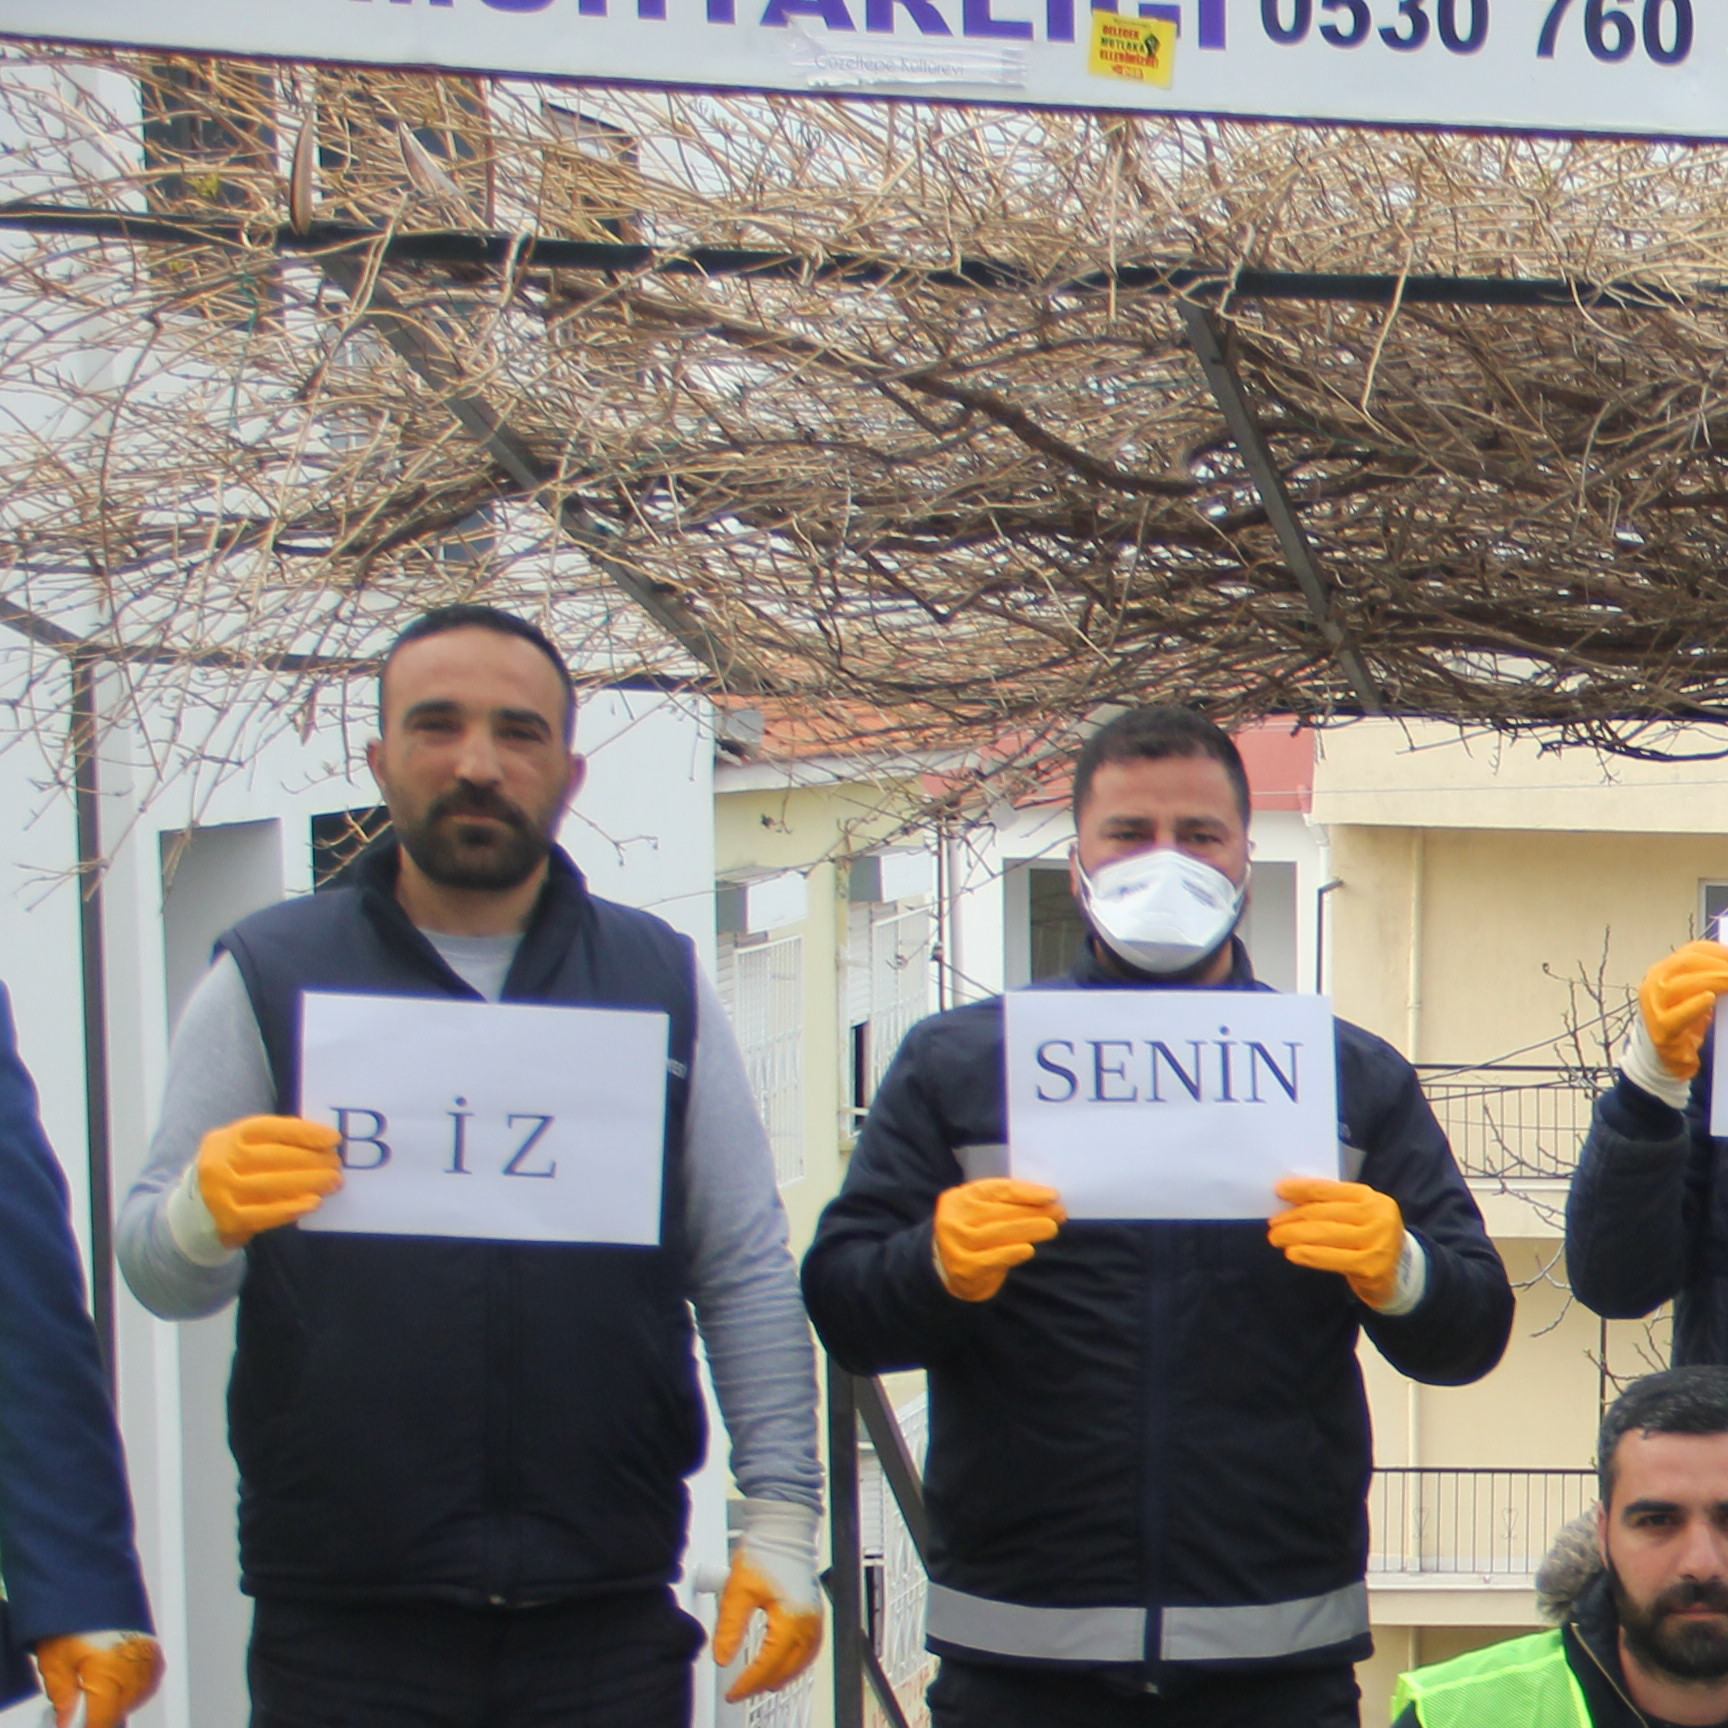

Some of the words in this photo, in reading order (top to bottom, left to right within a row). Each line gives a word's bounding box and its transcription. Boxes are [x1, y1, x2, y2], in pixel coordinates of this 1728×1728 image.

[1259, 0, 1490, 56] 0530
[1535, 0, 1694, 67] 760
[1035, 1025, 1303, 1104] SENİN
[331, 1095, 557, 1179] BİZ
